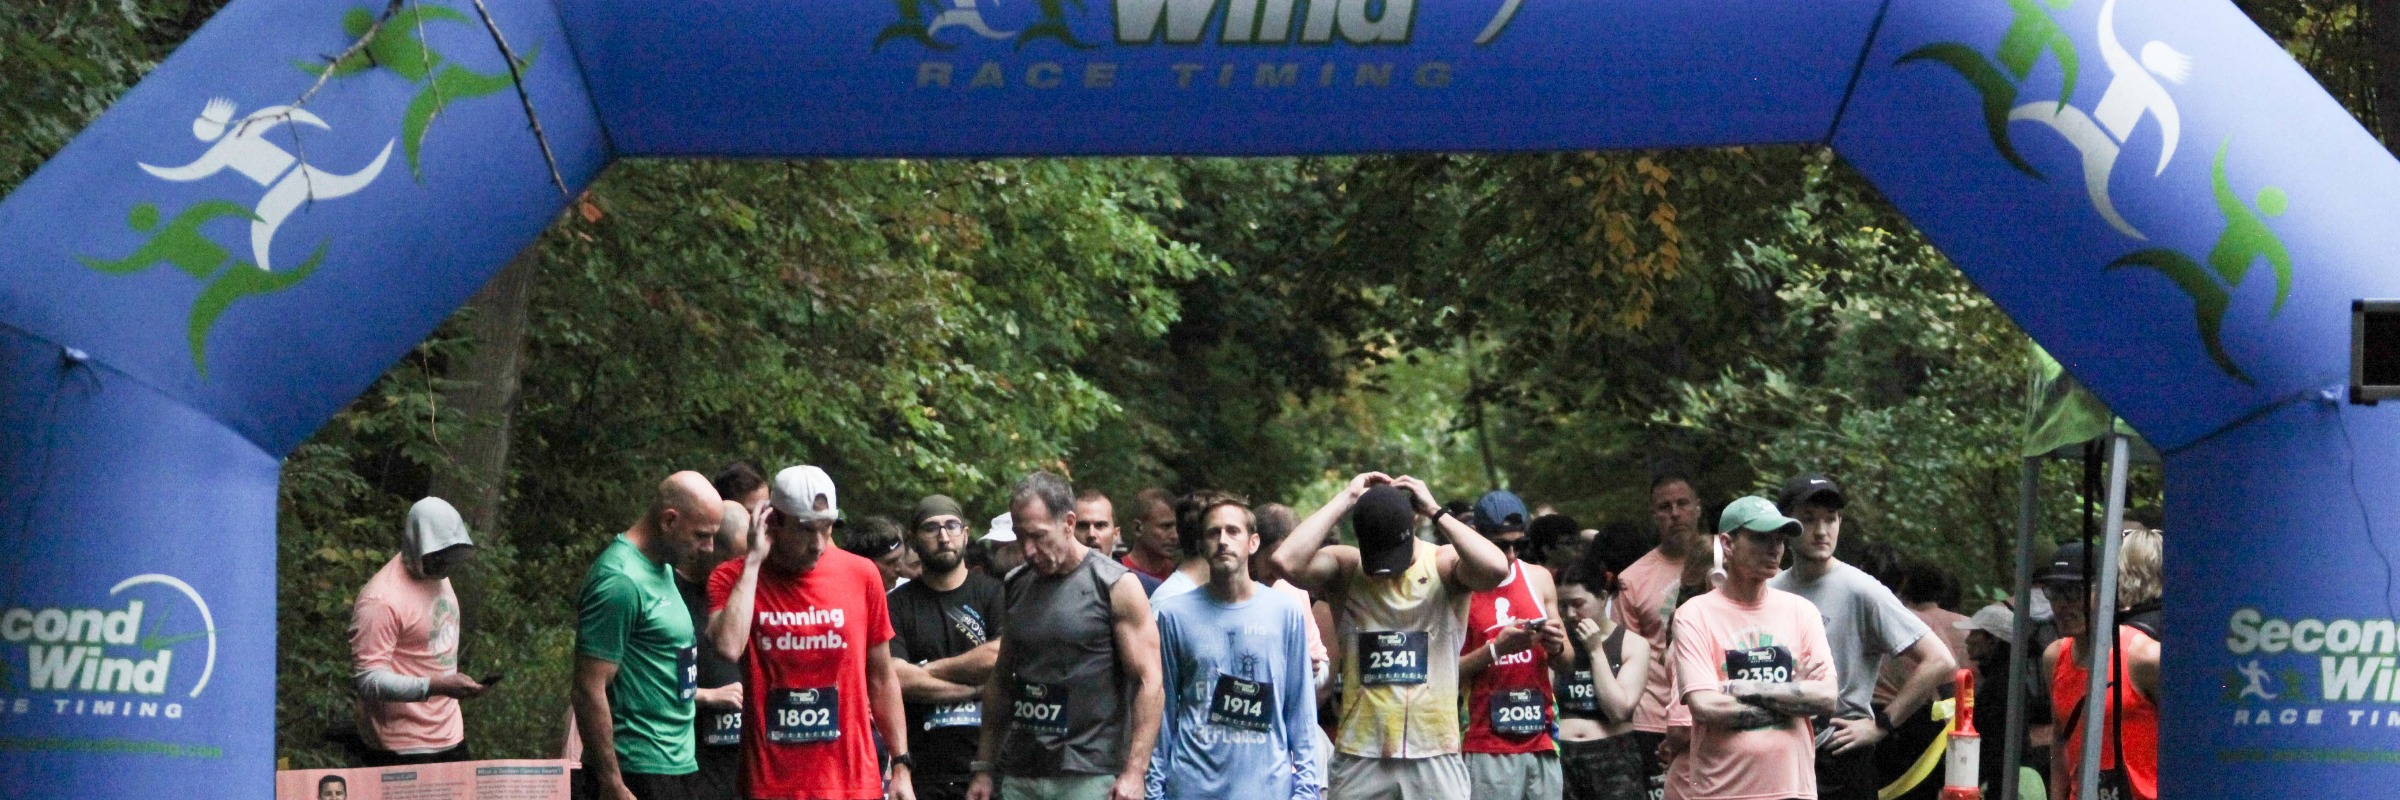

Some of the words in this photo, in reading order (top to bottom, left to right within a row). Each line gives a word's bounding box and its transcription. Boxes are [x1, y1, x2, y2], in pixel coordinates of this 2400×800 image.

[916, 62, 1117, 88] RACE
[1172, 62, 1455, 88] TIMING
[760, 605, 845, 628] running
[776, 629, 848, 650] dumb.
[2227, 608, 2400, 653] Secon
[1370, 650, 1416, 669] 2341
[1487, 648, 1532, 667] ERO
[28, 644, 173, 694] Wind
[1737, 665, 1788, 683] 2350
[2320, 656, 2400, 701] Wi
[54, 698, 183, 719] TIMING
[1014, 700, 1062, 721] 2007
[1223, 694, 1263, 718] 1914
[1498, 704, 1542, 722] 2083
[2232, 707, 2325, 726] RACE
[777, 707, 830, 727] 1802
